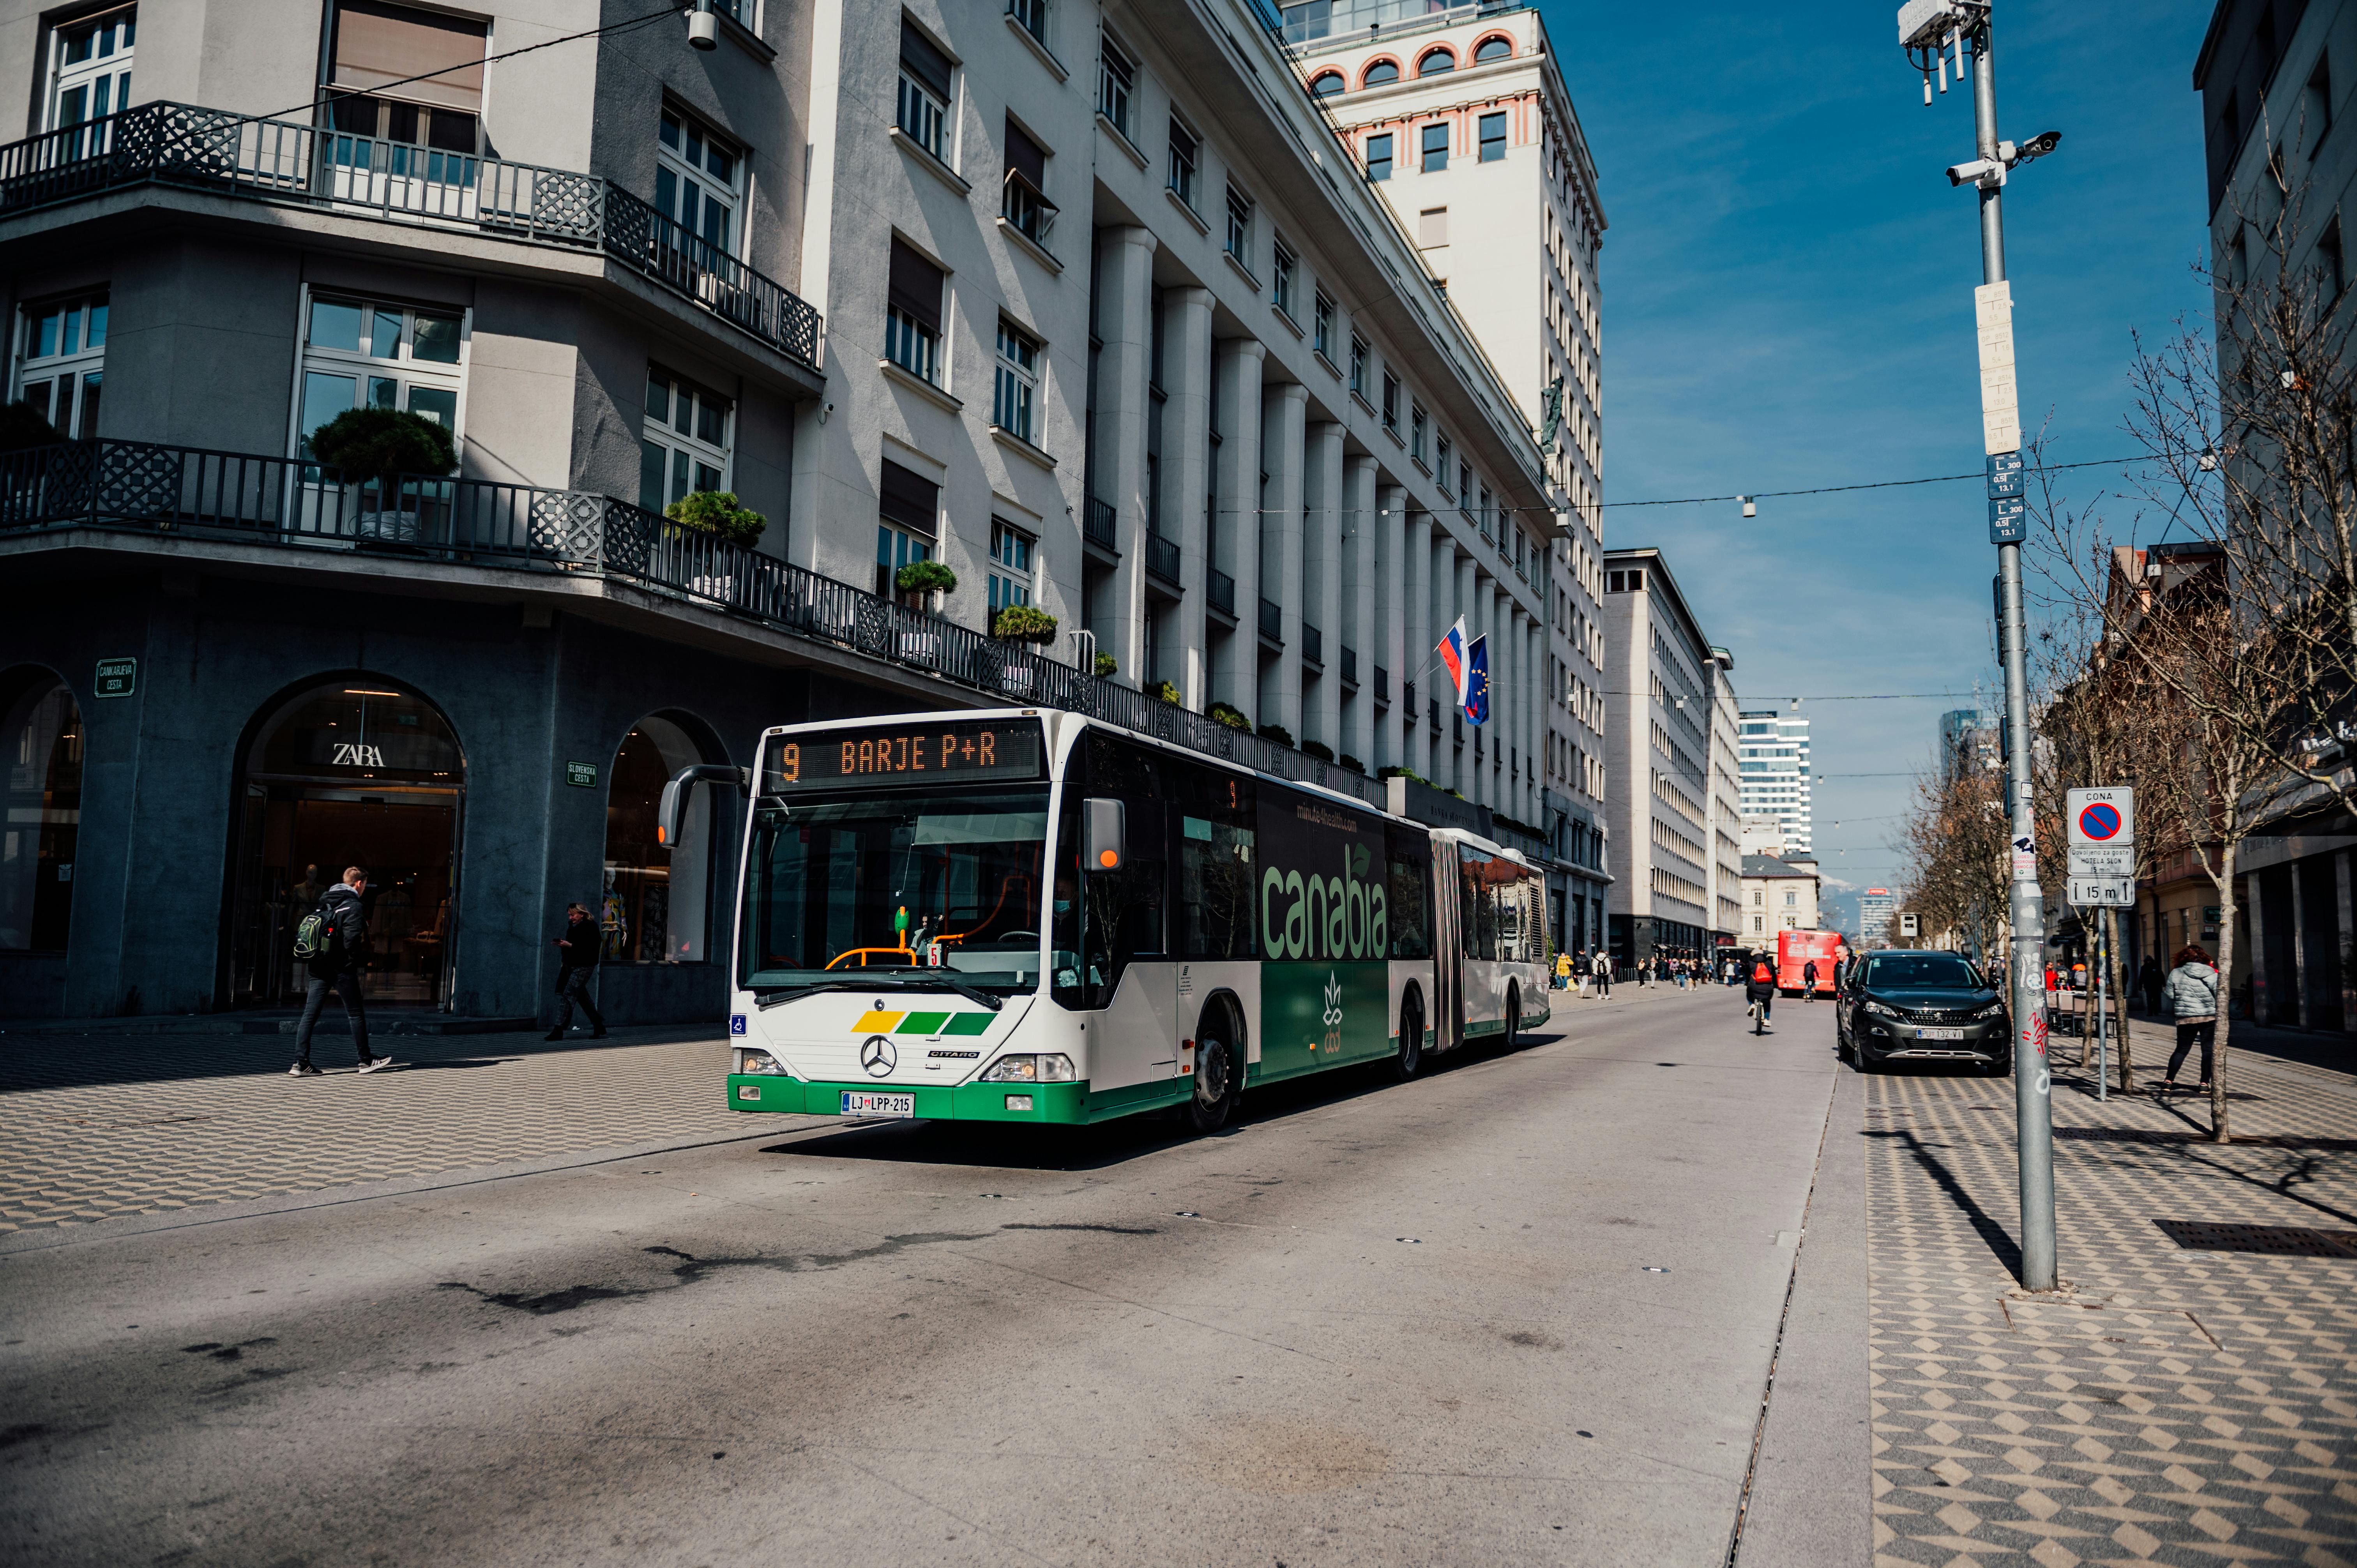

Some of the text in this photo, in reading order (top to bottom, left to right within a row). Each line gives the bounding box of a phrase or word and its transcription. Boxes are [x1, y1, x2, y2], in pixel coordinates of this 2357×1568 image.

[1996, 461, 2004, 470] L
[1998, 505, 2006, 514] L
[100, 665, 132, 676] CANKARJEVA
[107, 680, 122, 690] CESTA
[332, 743, 387, 767] ZARA
[783, 731, 995, 782] 9 BARJE P+R
[569, 764, 595, 775] SLOVENSKA
[575, 774, 589, 783] CESTA
[1297, 802, 1357, 833] minute4health.com
[1431, 805, 1475, 829] BANKA SLOVENIJE
[2087, 886, 2116, 898] 15 m
[1262, 843, 1387, 960] canabia
[931, 947, 937, 966] 5
[1325, 1025, 1341, 1054] cbd
[852, 1096, 863, 1109] LJ
